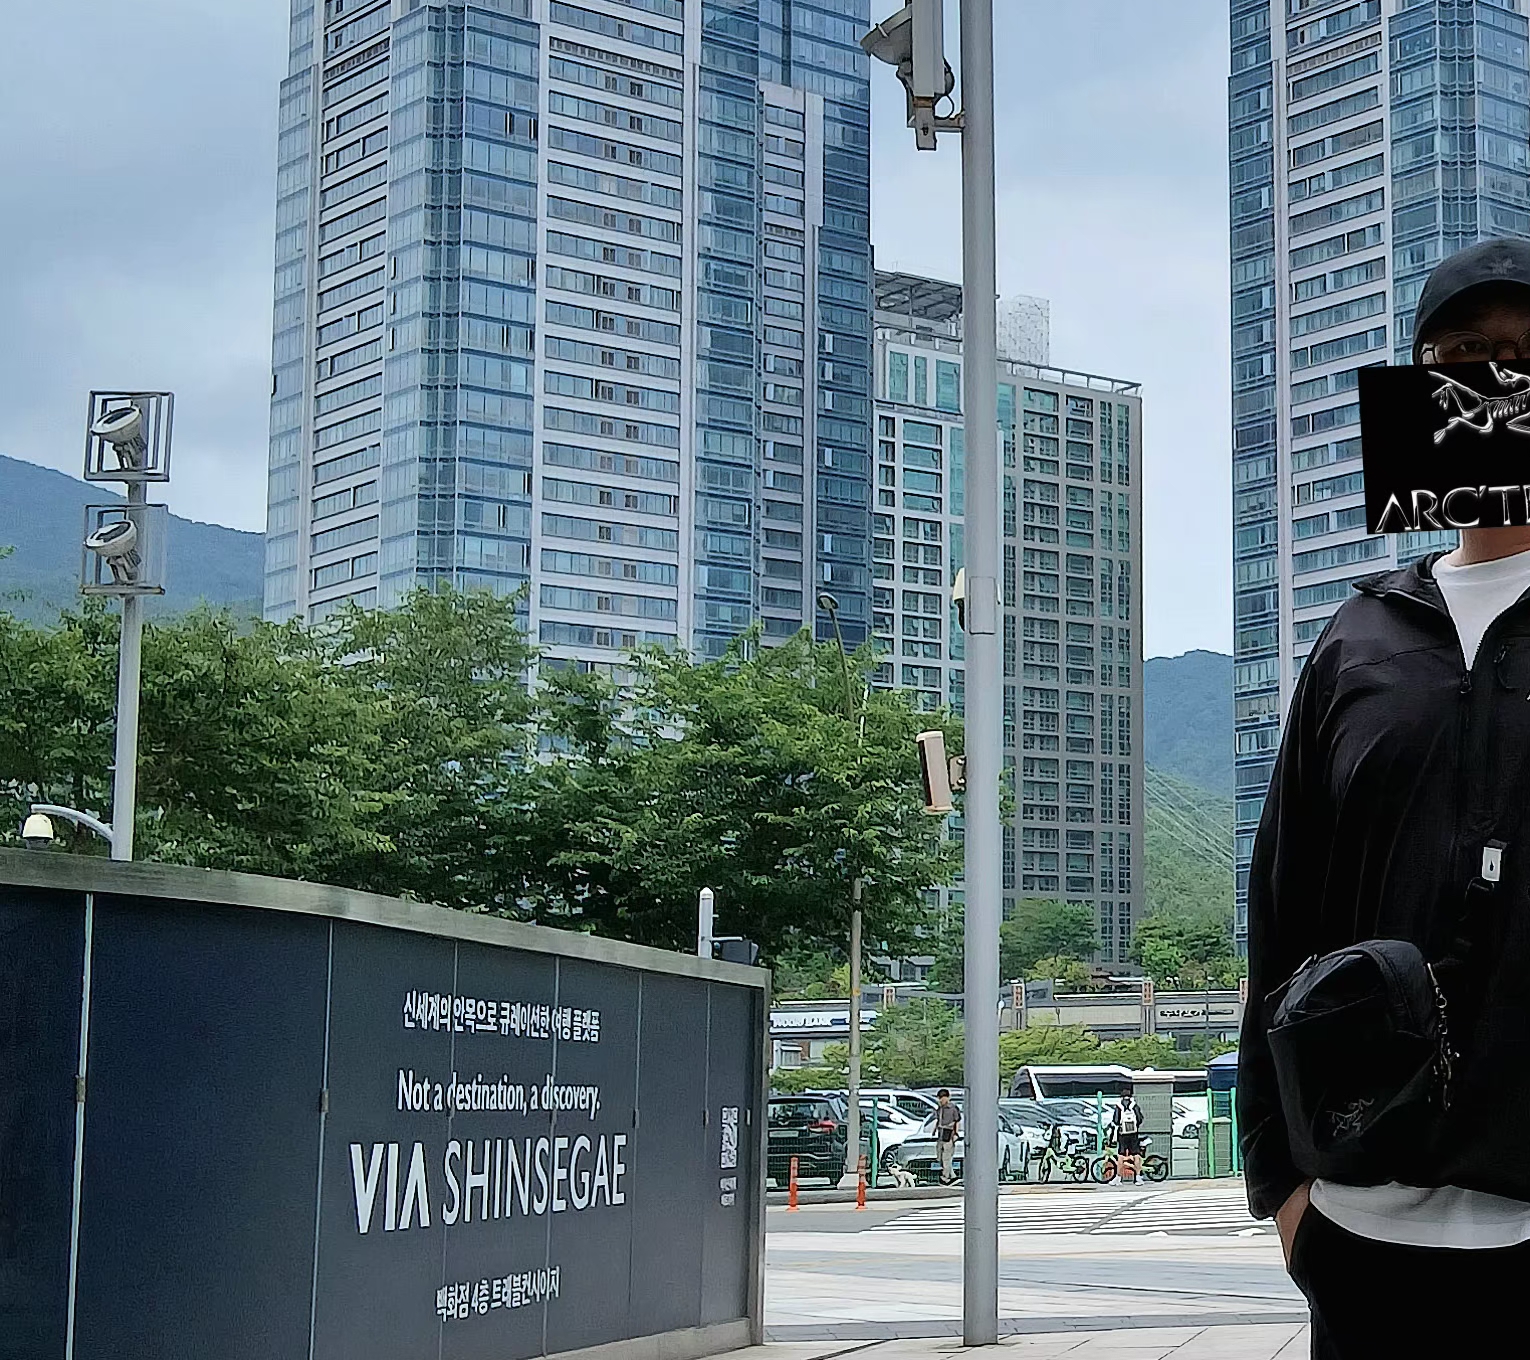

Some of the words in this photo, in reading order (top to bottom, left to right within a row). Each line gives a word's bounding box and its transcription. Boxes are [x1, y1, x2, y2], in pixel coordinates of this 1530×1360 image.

[403, 988, 452, 1033] 신세계의
[453, 995, 498, 1034] 안목으로
[573, 1009, 600, 1043] 플랫폼
[397, 1069, 430, 1111] Not
[433, 1082, 443, 1111] a
[447, 1071, 529, 1117] destination,
[530, 1084, 539, 1111] a
[541, 1073, 601, 1121] discovery.
[349, 1142, 431, 1234] VIA
[441, 1134, 628, 1226] SHINSEGAE
[436, 1281, 470, 1323] 백화점
[471, 1279, 490, 1316] 4층
